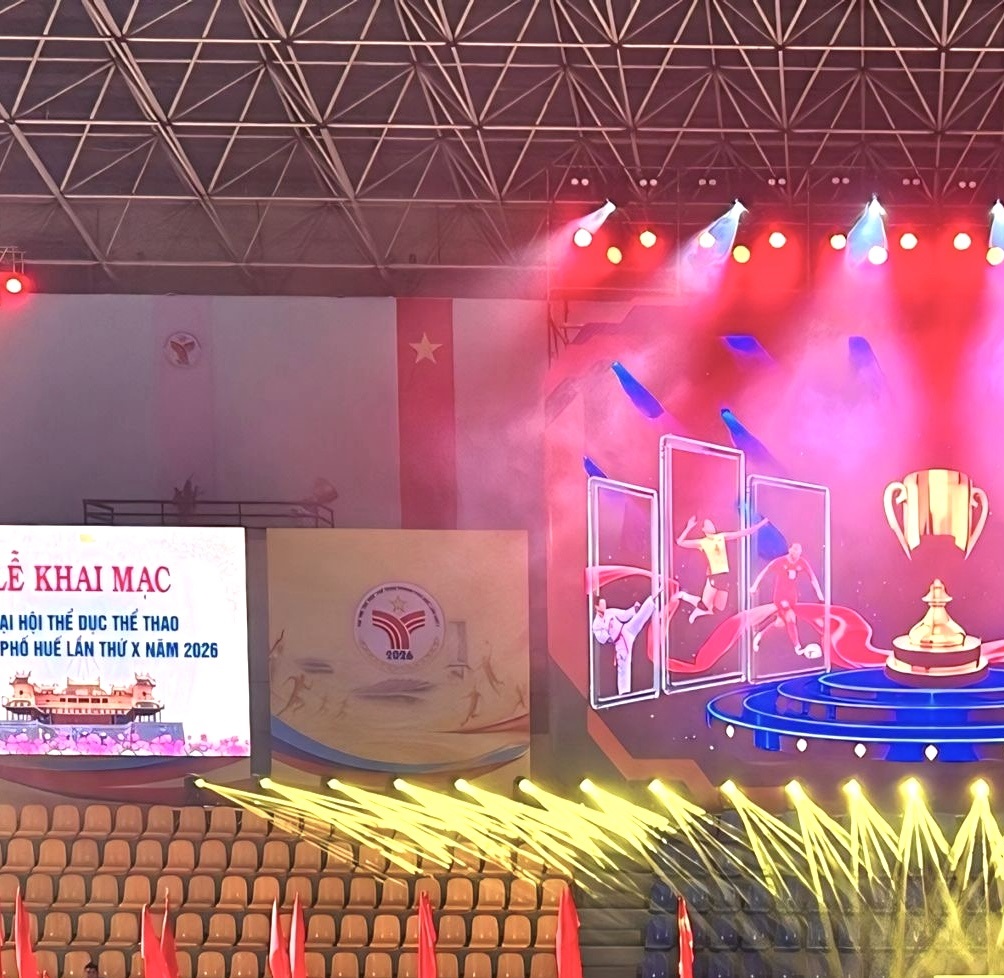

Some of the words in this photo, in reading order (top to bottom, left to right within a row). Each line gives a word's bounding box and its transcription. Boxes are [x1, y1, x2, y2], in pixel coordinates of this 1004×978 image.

[34, 565, 103, 592] KHAI
[111, 565, 171, 600] MẠC
[19, 611, 42, 634] HỘI
[79, 615, 107, 635] DỤC
[143, 615, 179, 632] THAO
[34, 635, 62, 657] HUẾ
[131, 642, 141, 658] X
[183, 642, 218, 659] 2026
[386, 650, 414, 660] 2026
